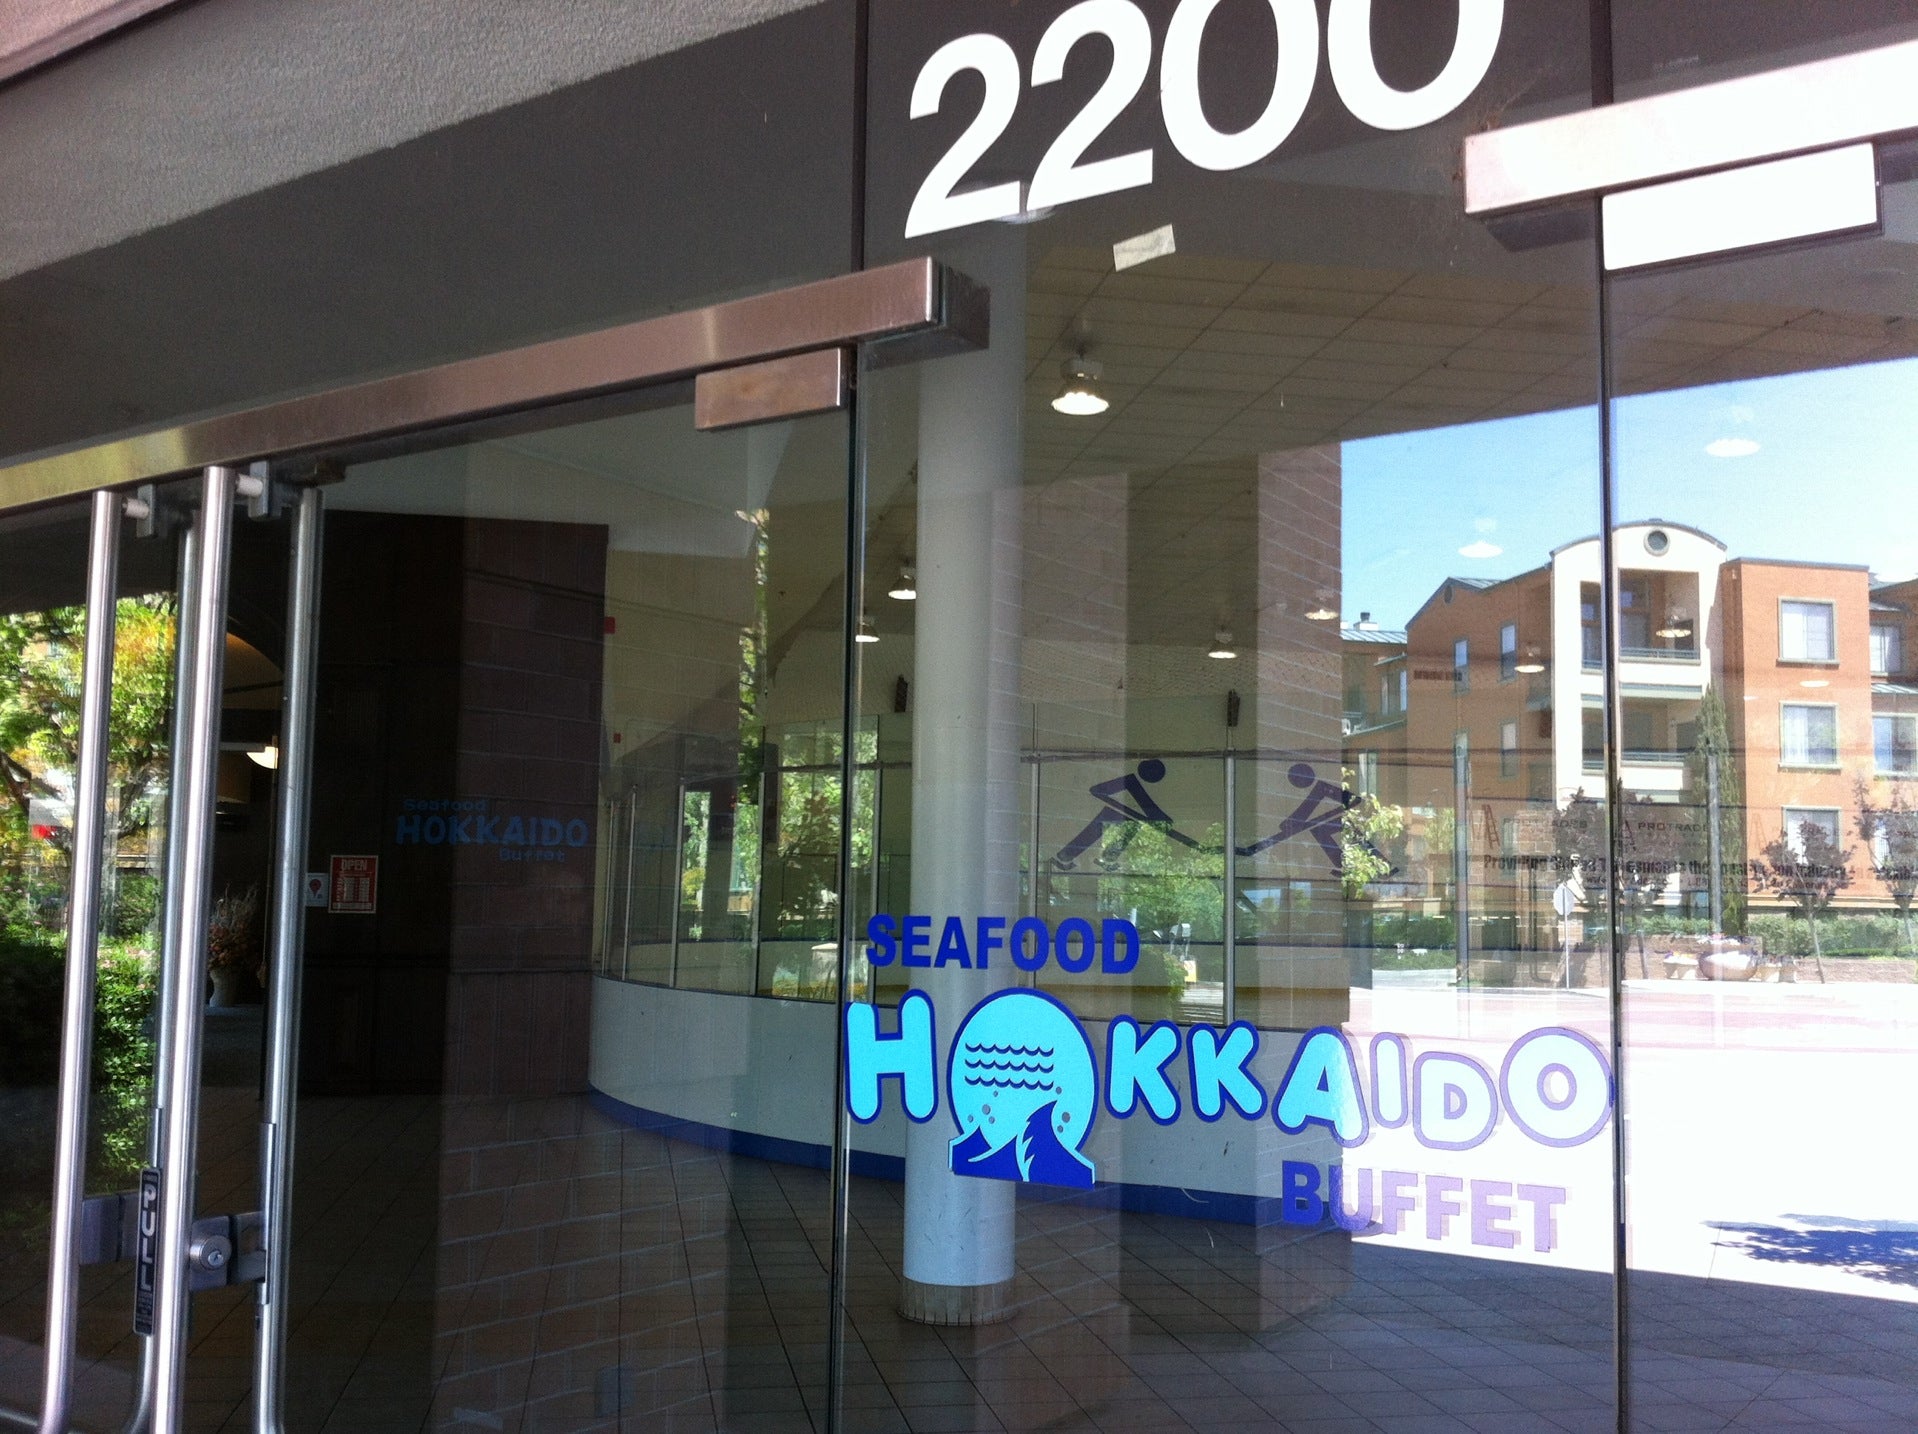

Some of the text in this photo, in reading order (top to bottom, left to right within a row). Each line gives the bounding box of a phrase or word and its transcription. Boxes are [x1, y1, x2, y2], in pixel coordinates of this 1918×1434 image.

[904, 0, 1504, 239] 2200
[395, 814, 590, 847] HOKKAIDO
[1503, 817, 1588, 831] PROTADES
[866, 913, 1139, 974] SEAFOOD
[845, 987, 1614, 1189] HOKKAIDO
[141, 1184, 156, 1291] PULL
[1281, 1160, 1567, 1253] BUFFET
